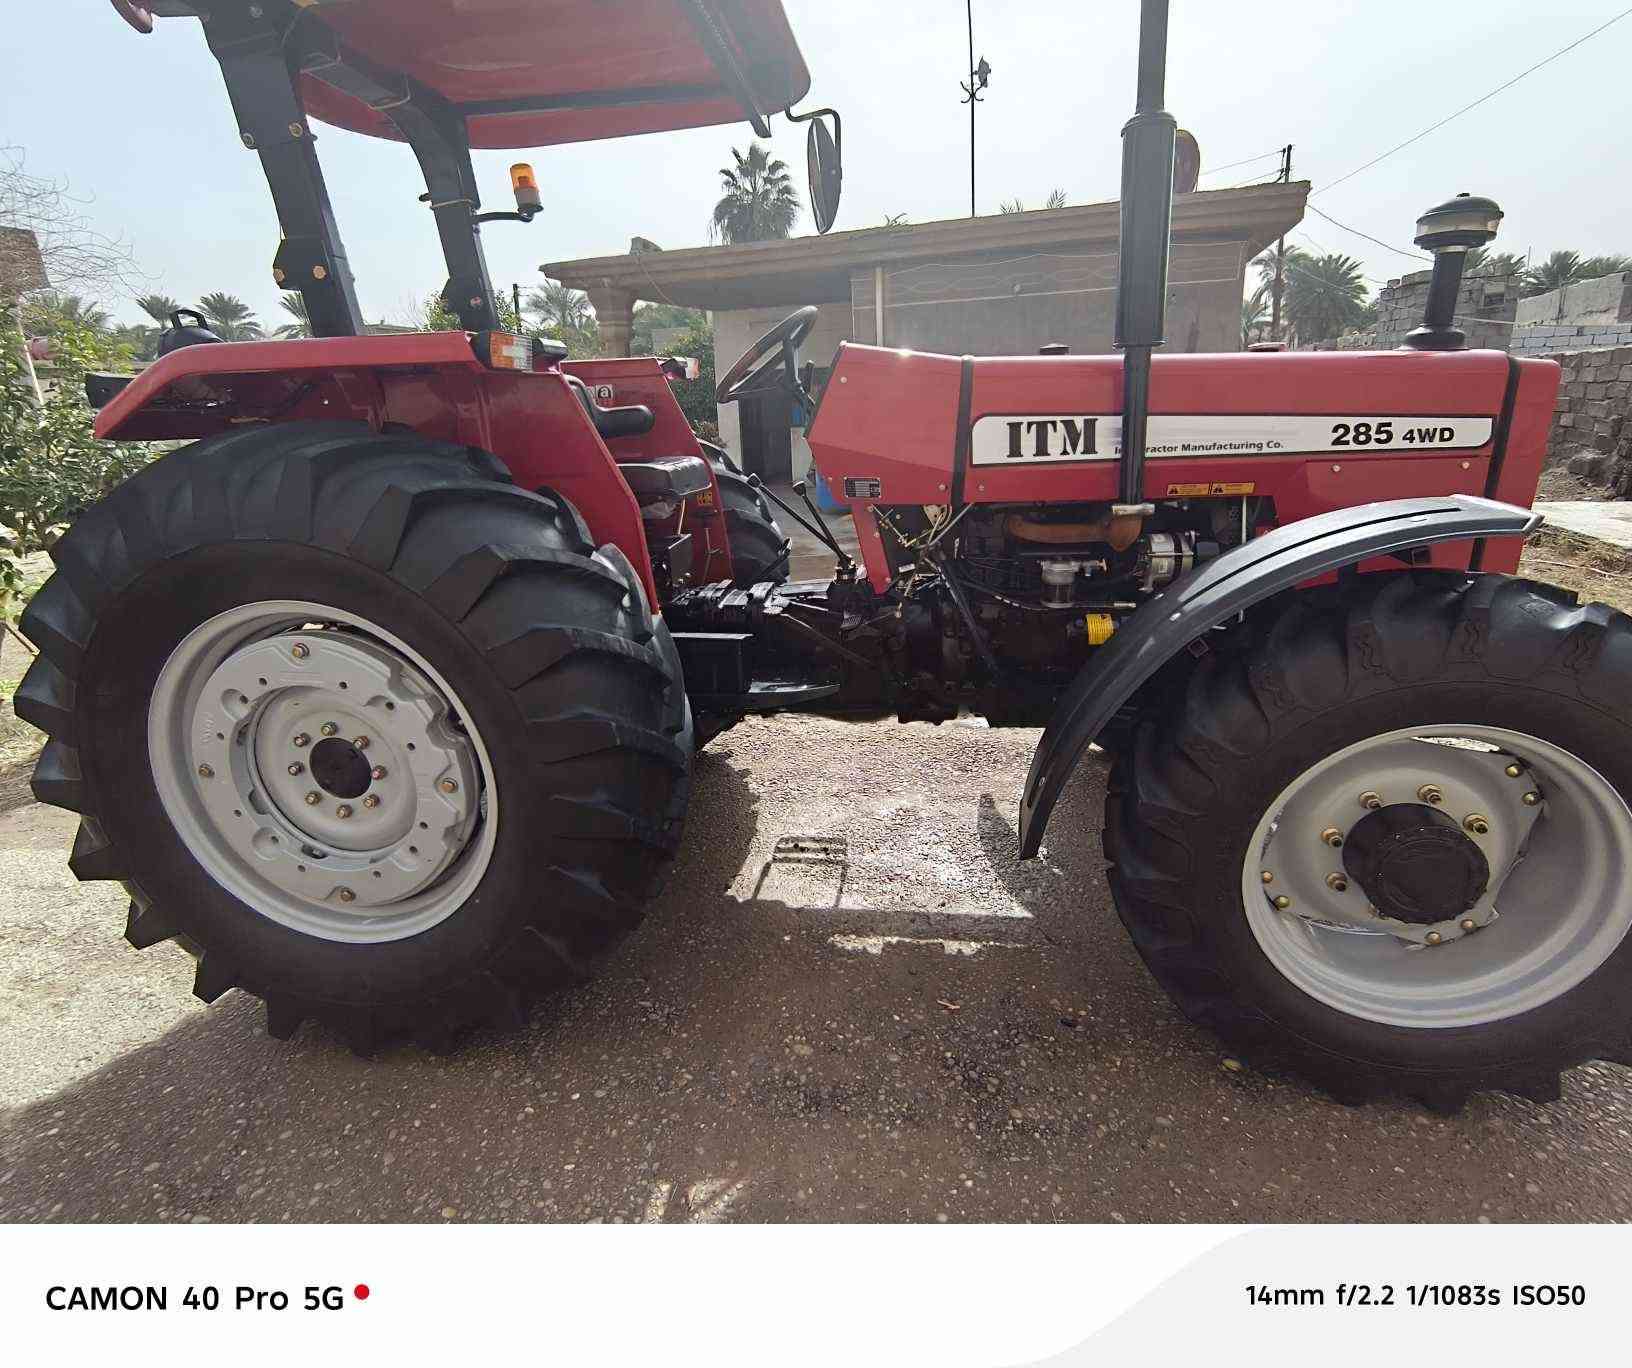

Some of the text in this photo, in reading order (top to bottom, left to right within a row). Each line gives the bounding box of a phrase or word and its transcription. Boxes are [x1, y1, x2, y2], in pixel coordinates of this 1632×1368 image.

[1006, 418, 1099, 458] ITM
[1331, 421, 1455, 446] 285 4WD
[1144, 440, 1284, 453] ractor Manufacturing Co.
